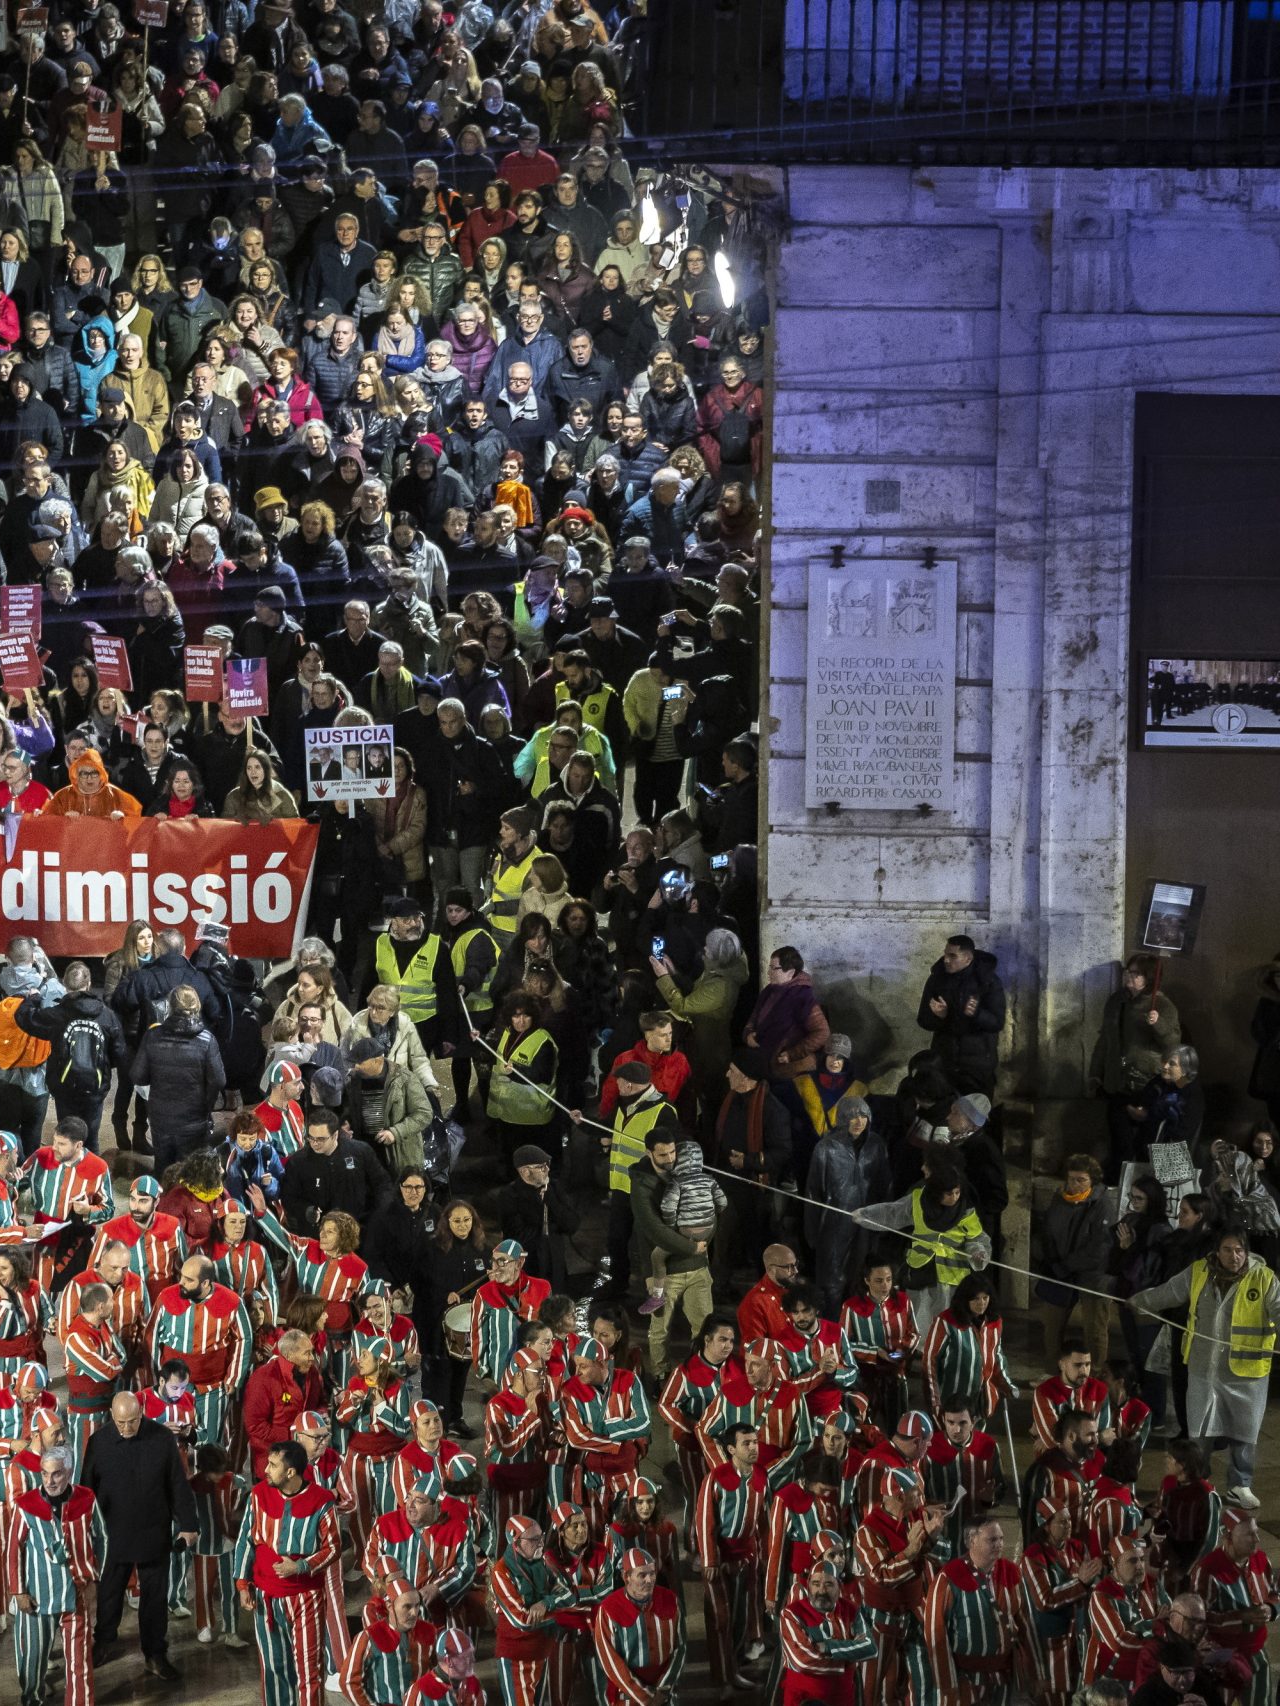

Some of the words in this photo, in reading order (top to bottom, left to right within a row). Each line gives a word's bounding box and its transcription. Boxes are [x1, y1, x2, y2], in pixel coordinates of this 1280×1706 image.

[0, 648, 9, 656] no
[8, 646, 16, 655] hi
[15, 645, 25, 653] ha
[186, 648, 207, 656] Sense
[187, 658, 196, 666] no
[196, 657, 204, 666] hi
[204, 658, 213, 666] ha
[817, 657, 836, 668] EN
[841, 657, 895, 669] RECORD
[901, 658, 920, 669] DE
[926, 659, 944, 669] LA
[187, 666, 214, 675] infància
[818, 670, 861, 681] VISITA
[866, 671, 876, 681] A
[878, 671, 944, 682] VALENCIA
[229, 689, 255, 698] Rovira
[912, 685, 943, 696] PAPA
[230, 696, 263, 708] dimissió
[825, 699, 876, 716] JOAN
[884, 700, 919, 717] PAV
[925, 700, 935, 717] II
[816, 719, 831, 731] EL
[833, 720, 853, 731] VIII
[875, 721, 942, 732] NOVEMBRE
[308, 728, 391, 745] JUSTICIA
[816, 733, 835, 744] DE
[876, 735, 943, 746] MCMLXXXII
[816, 747, 863, 758] ESSENT
[821, 774, 880, 785] ALCALDE
[816, 787, 860, 798] RICARD
[892, 788, 943, 799] CASADO
[1, 850, 292, 925] dimissió
